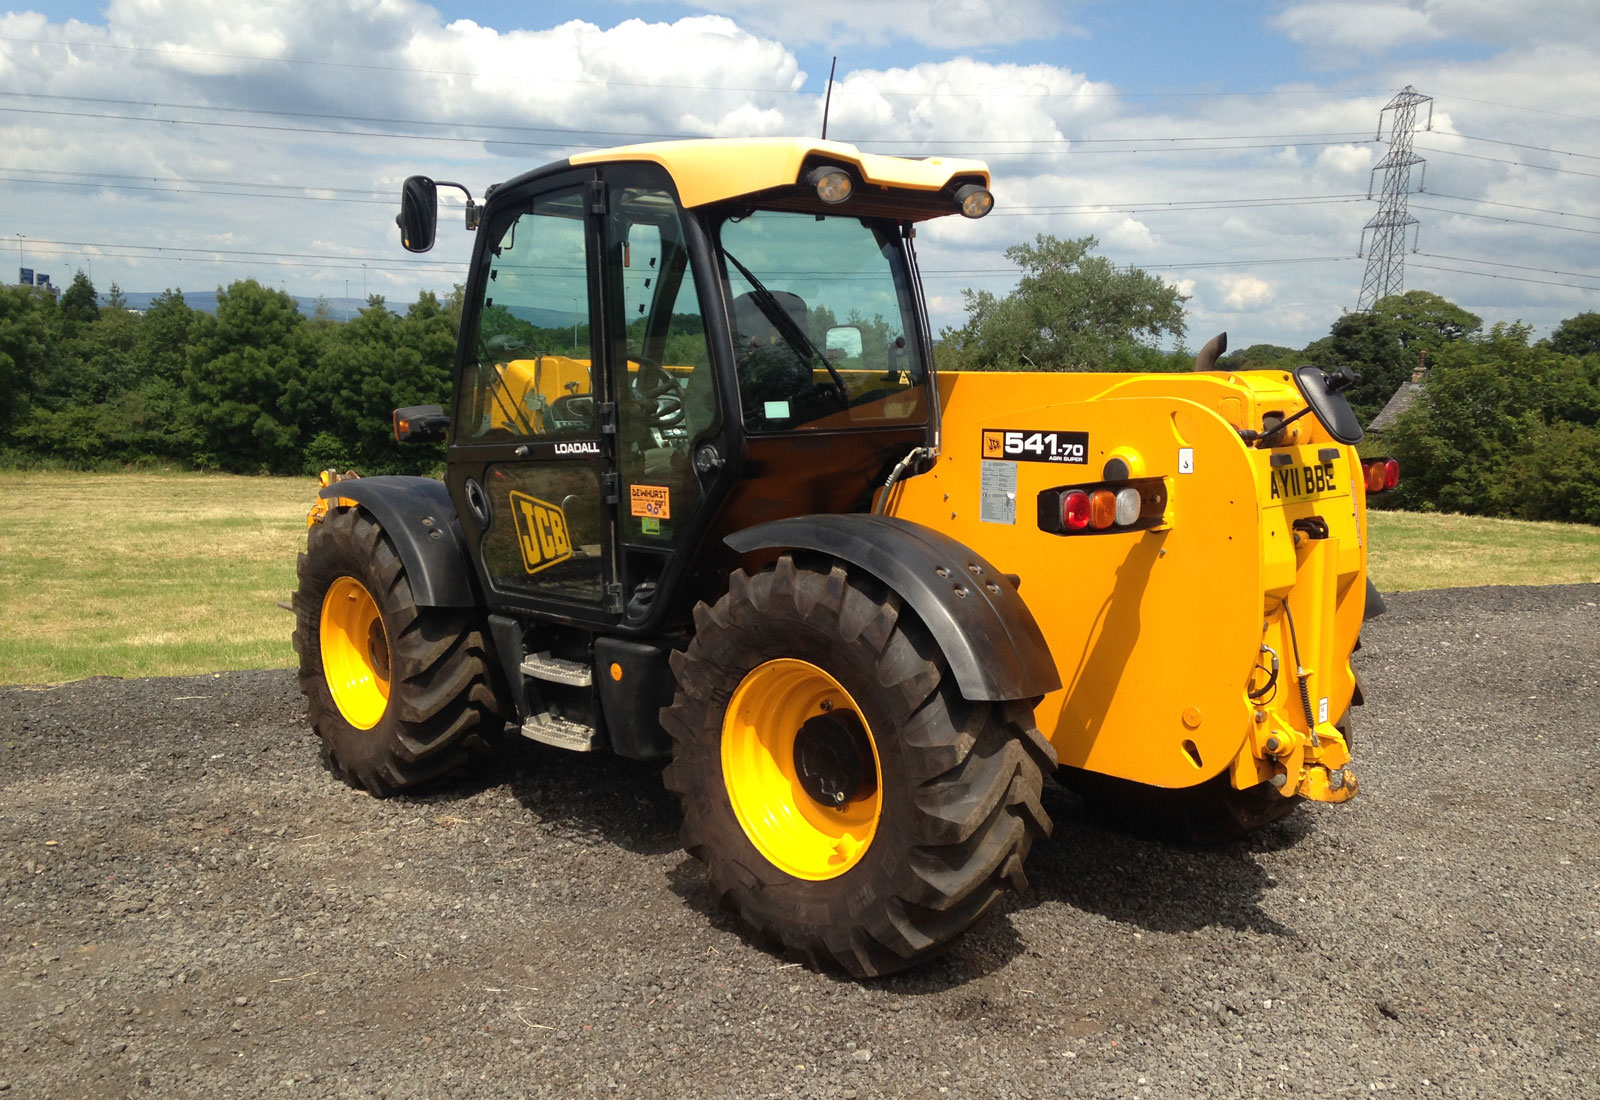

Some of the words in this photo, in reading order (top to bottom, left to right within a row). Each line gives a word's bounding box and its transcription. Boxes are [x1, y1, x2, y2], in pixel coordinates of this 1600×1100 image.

[554, 442, 600, 454] LOADALL
[988, 437, 1001, 451] JCB
[1303, 463, 1336, 494] BBE
[632, 488, 667, 499] DEWHURST
[519, 500, 570, 565] JCB
